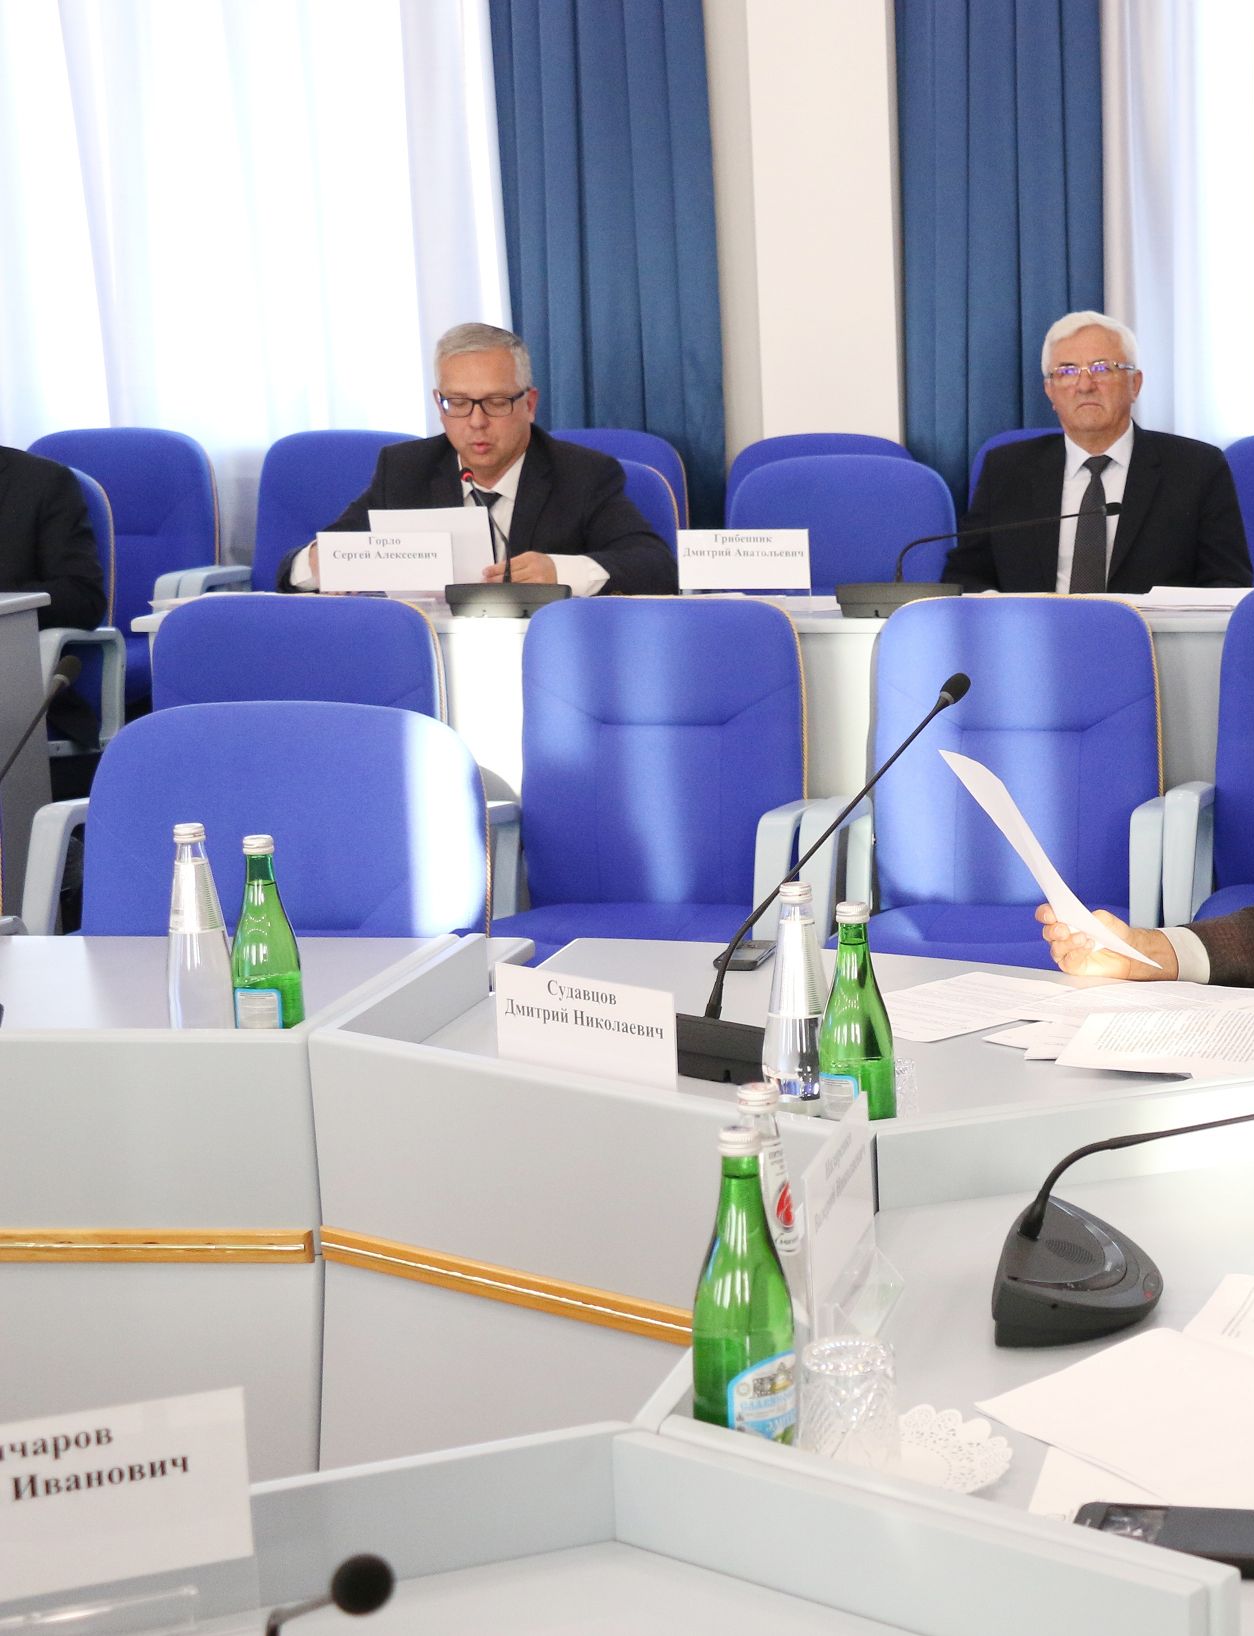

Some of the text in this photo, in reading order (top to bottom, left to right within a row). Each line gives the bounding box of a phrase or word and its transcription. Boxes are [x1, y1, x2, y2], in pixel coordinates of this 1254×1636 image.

[368, 536, 402, 547] Горло
[333, 550, 371, 561] Сергей
[683, 548, 732, 559] Дмитрий
[547, 979, 617, 1006] Судавцов
[505, 998, 664, 1040] Дмитрий Николаевич
[12, 1455, 190, 1502] Иванович
